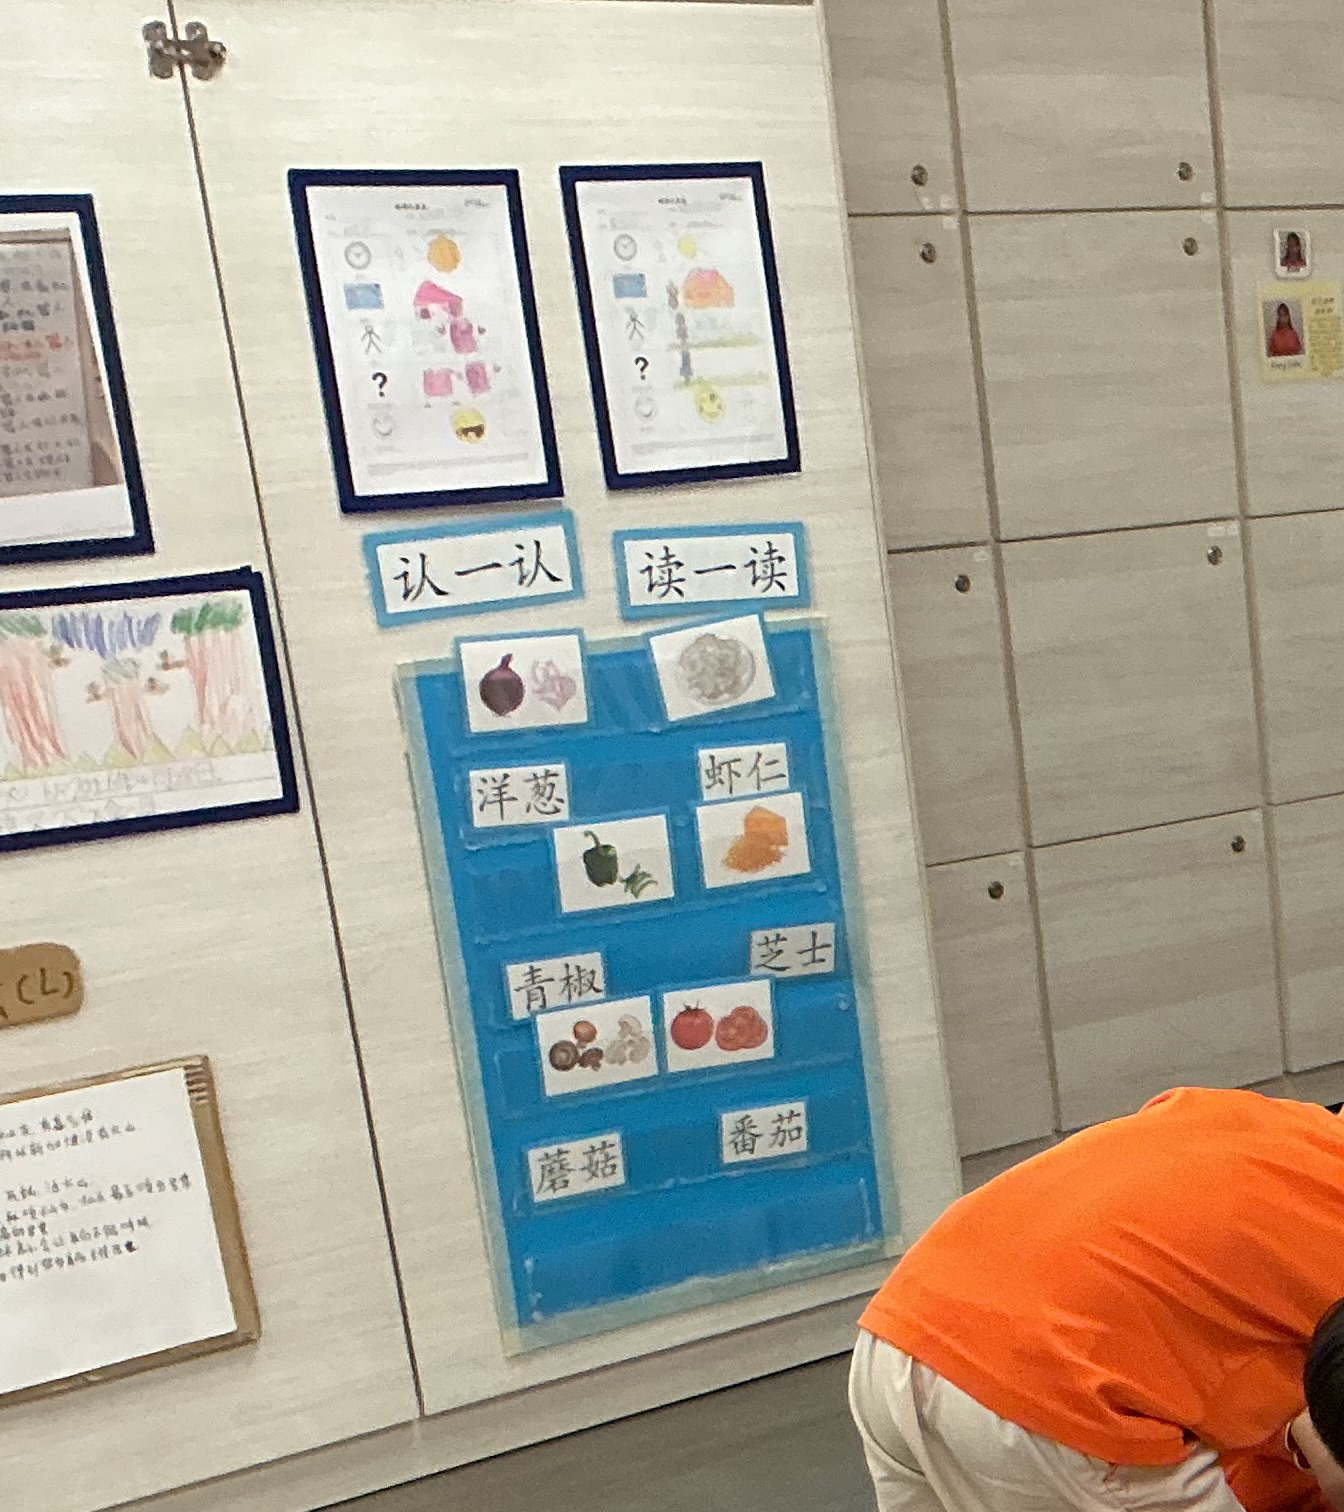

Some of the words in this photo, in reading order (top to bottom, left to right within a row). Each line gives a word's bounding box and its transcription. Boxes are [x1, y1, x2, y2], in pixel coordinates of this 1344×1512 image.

[393, 539, 562, 602] 认一认
[640, 541, 787, 598] 读一读
[476, 770, 565, 821] 洋葱
[705, 750, 787, 796] 虾仁
[756, 931, 833, 972] 芝士
[514, 963, 603, 1011] 青椒
[729, 1110, 804, 1156] 番茄
[535, 1141, 618, 1193] 蘑菇
